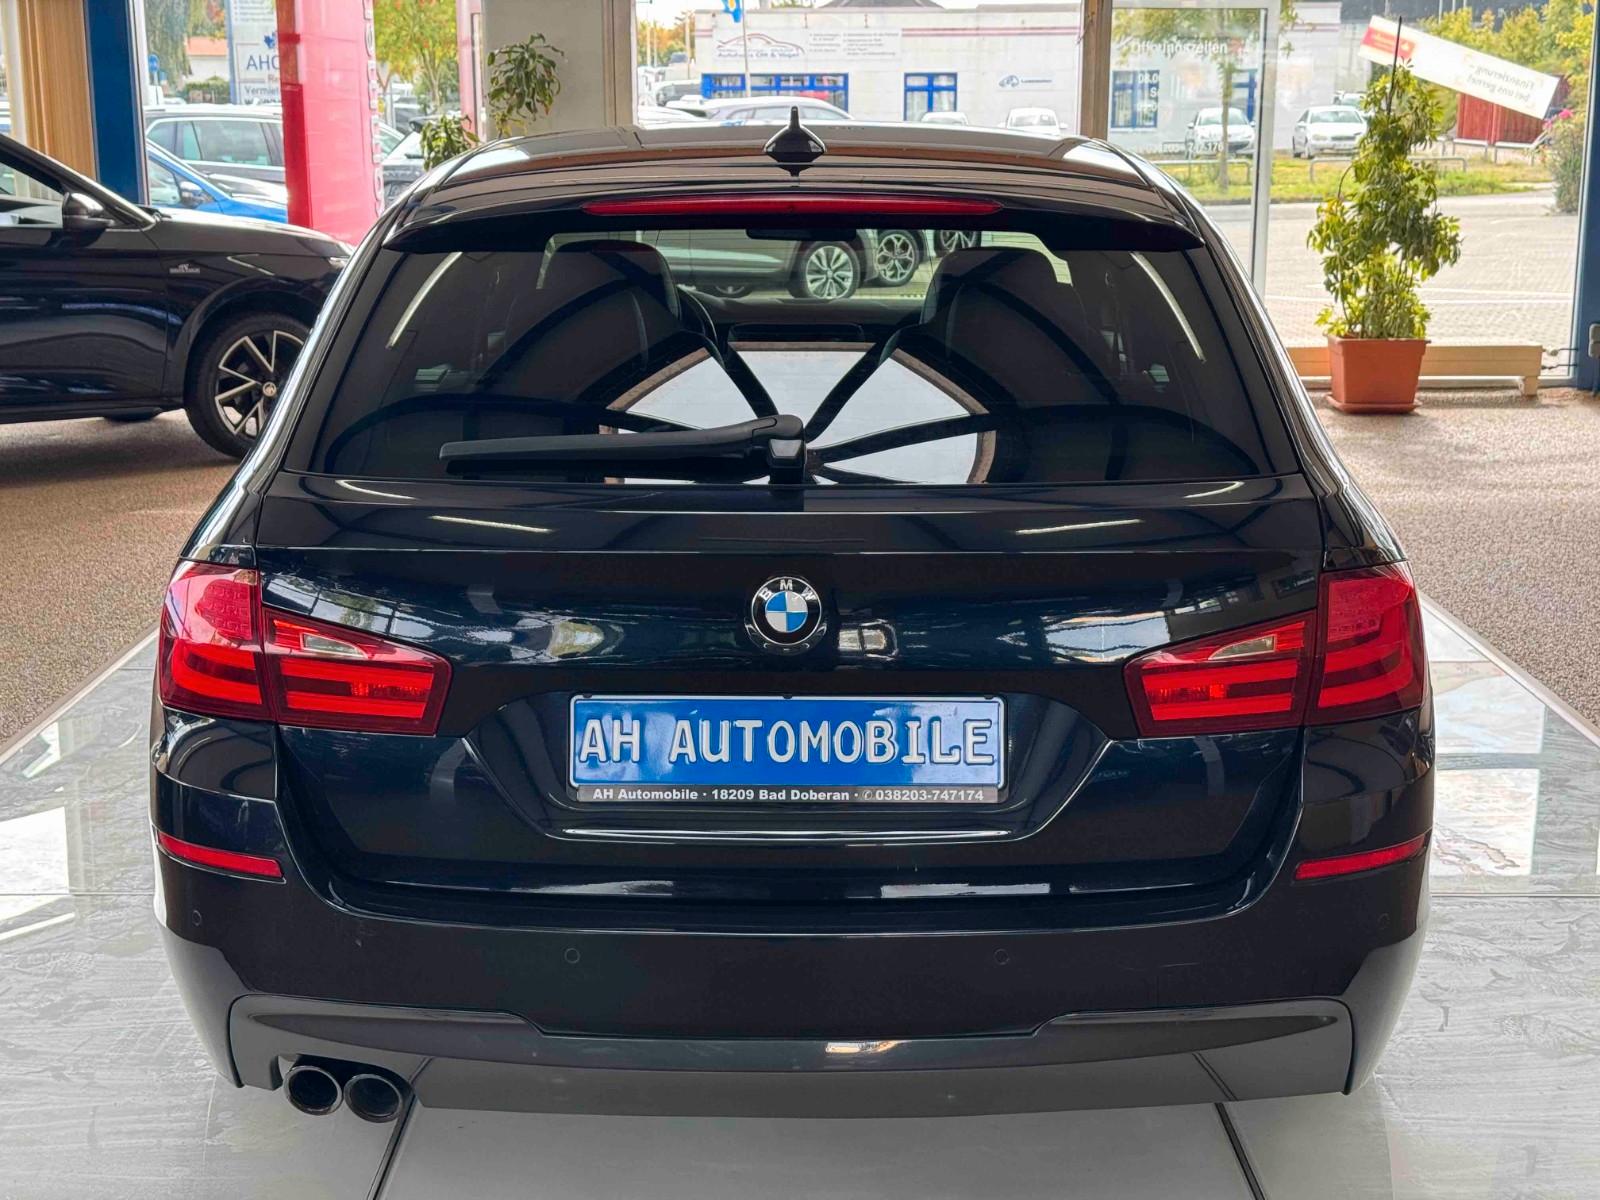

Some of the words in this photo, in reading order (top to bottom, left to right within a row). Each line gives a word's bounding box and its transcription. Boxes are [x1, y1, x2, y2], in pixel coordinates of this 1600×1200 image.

[761, 578, 816, 602] BMW
[578, 719, 642, 765] AH
[668, 719, 996, 766] AUTOMOBILE
[592, 789, 614, 801] AH
[618, 788, 699, 801] Automobile
[711, 789, 755, 801] 18209
[758, 789, 786, 801] Bad
[790, 789, 850, 801] Doberan
[875, 789, 984, 802] 038203-747174
